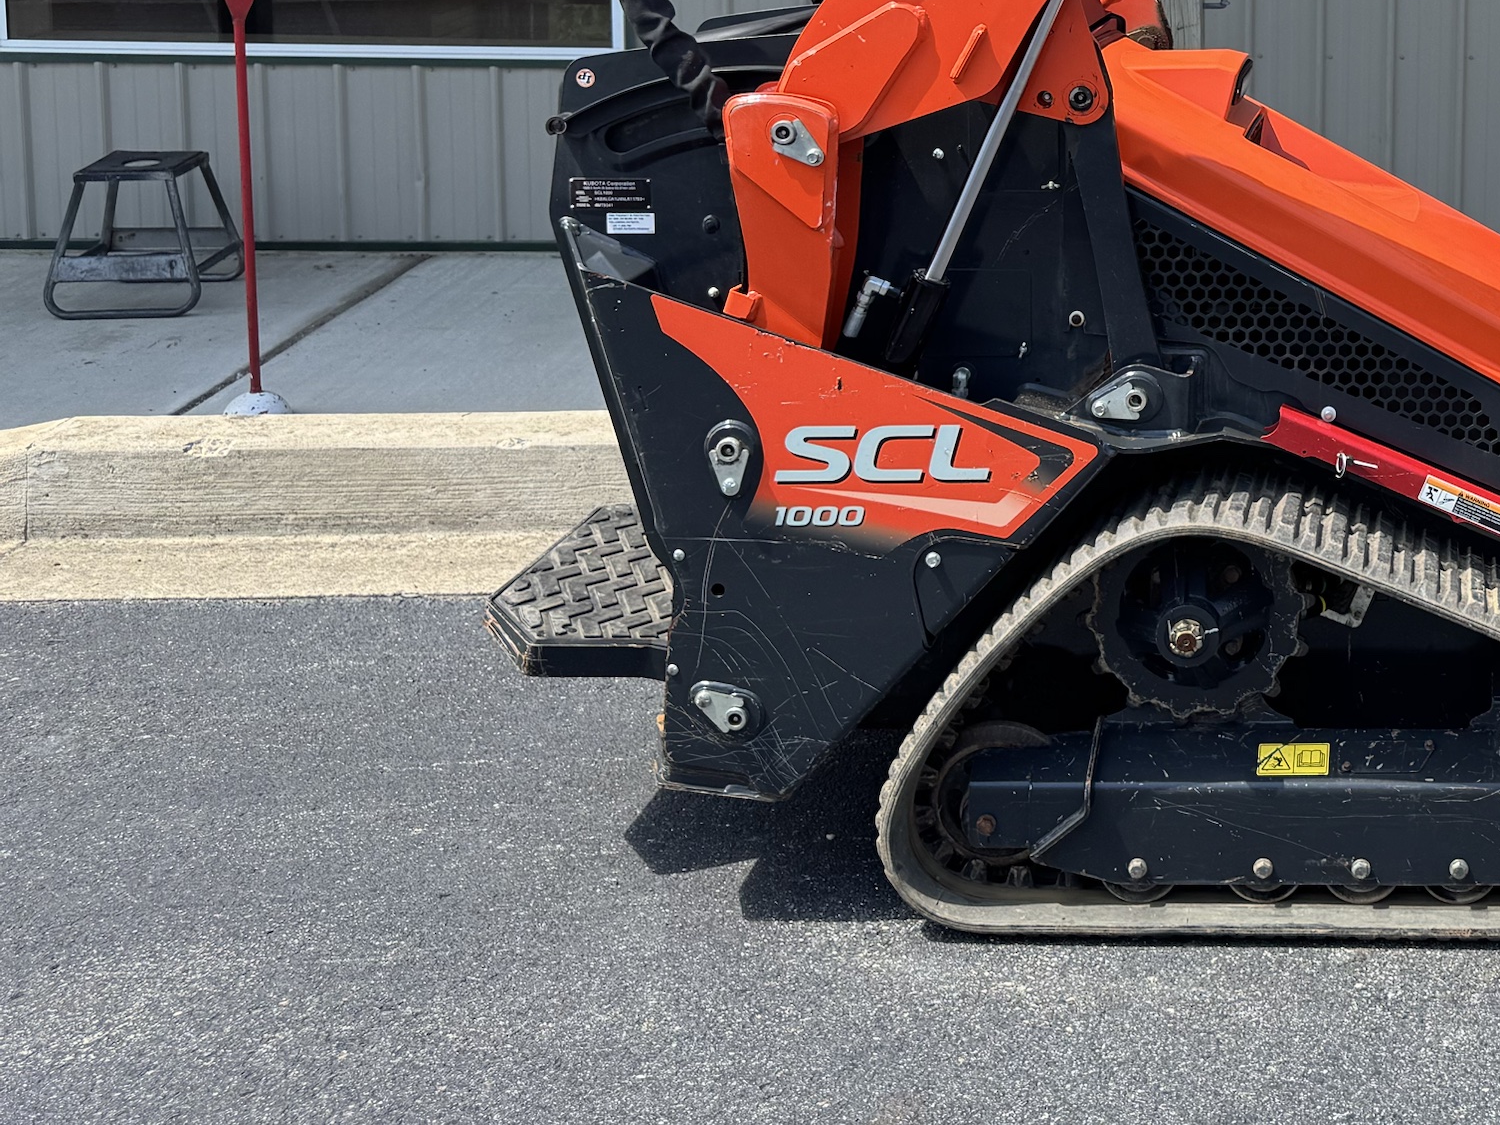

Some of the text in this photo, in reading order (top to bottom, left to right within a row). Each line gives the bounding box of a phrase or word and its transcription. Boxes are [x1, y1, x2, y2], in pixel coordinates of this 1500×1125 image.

[774, 424, 993, 484] SCL
[1464, 493, 1491, 509] WARNING
[774, 505, 866, 528] 1000
